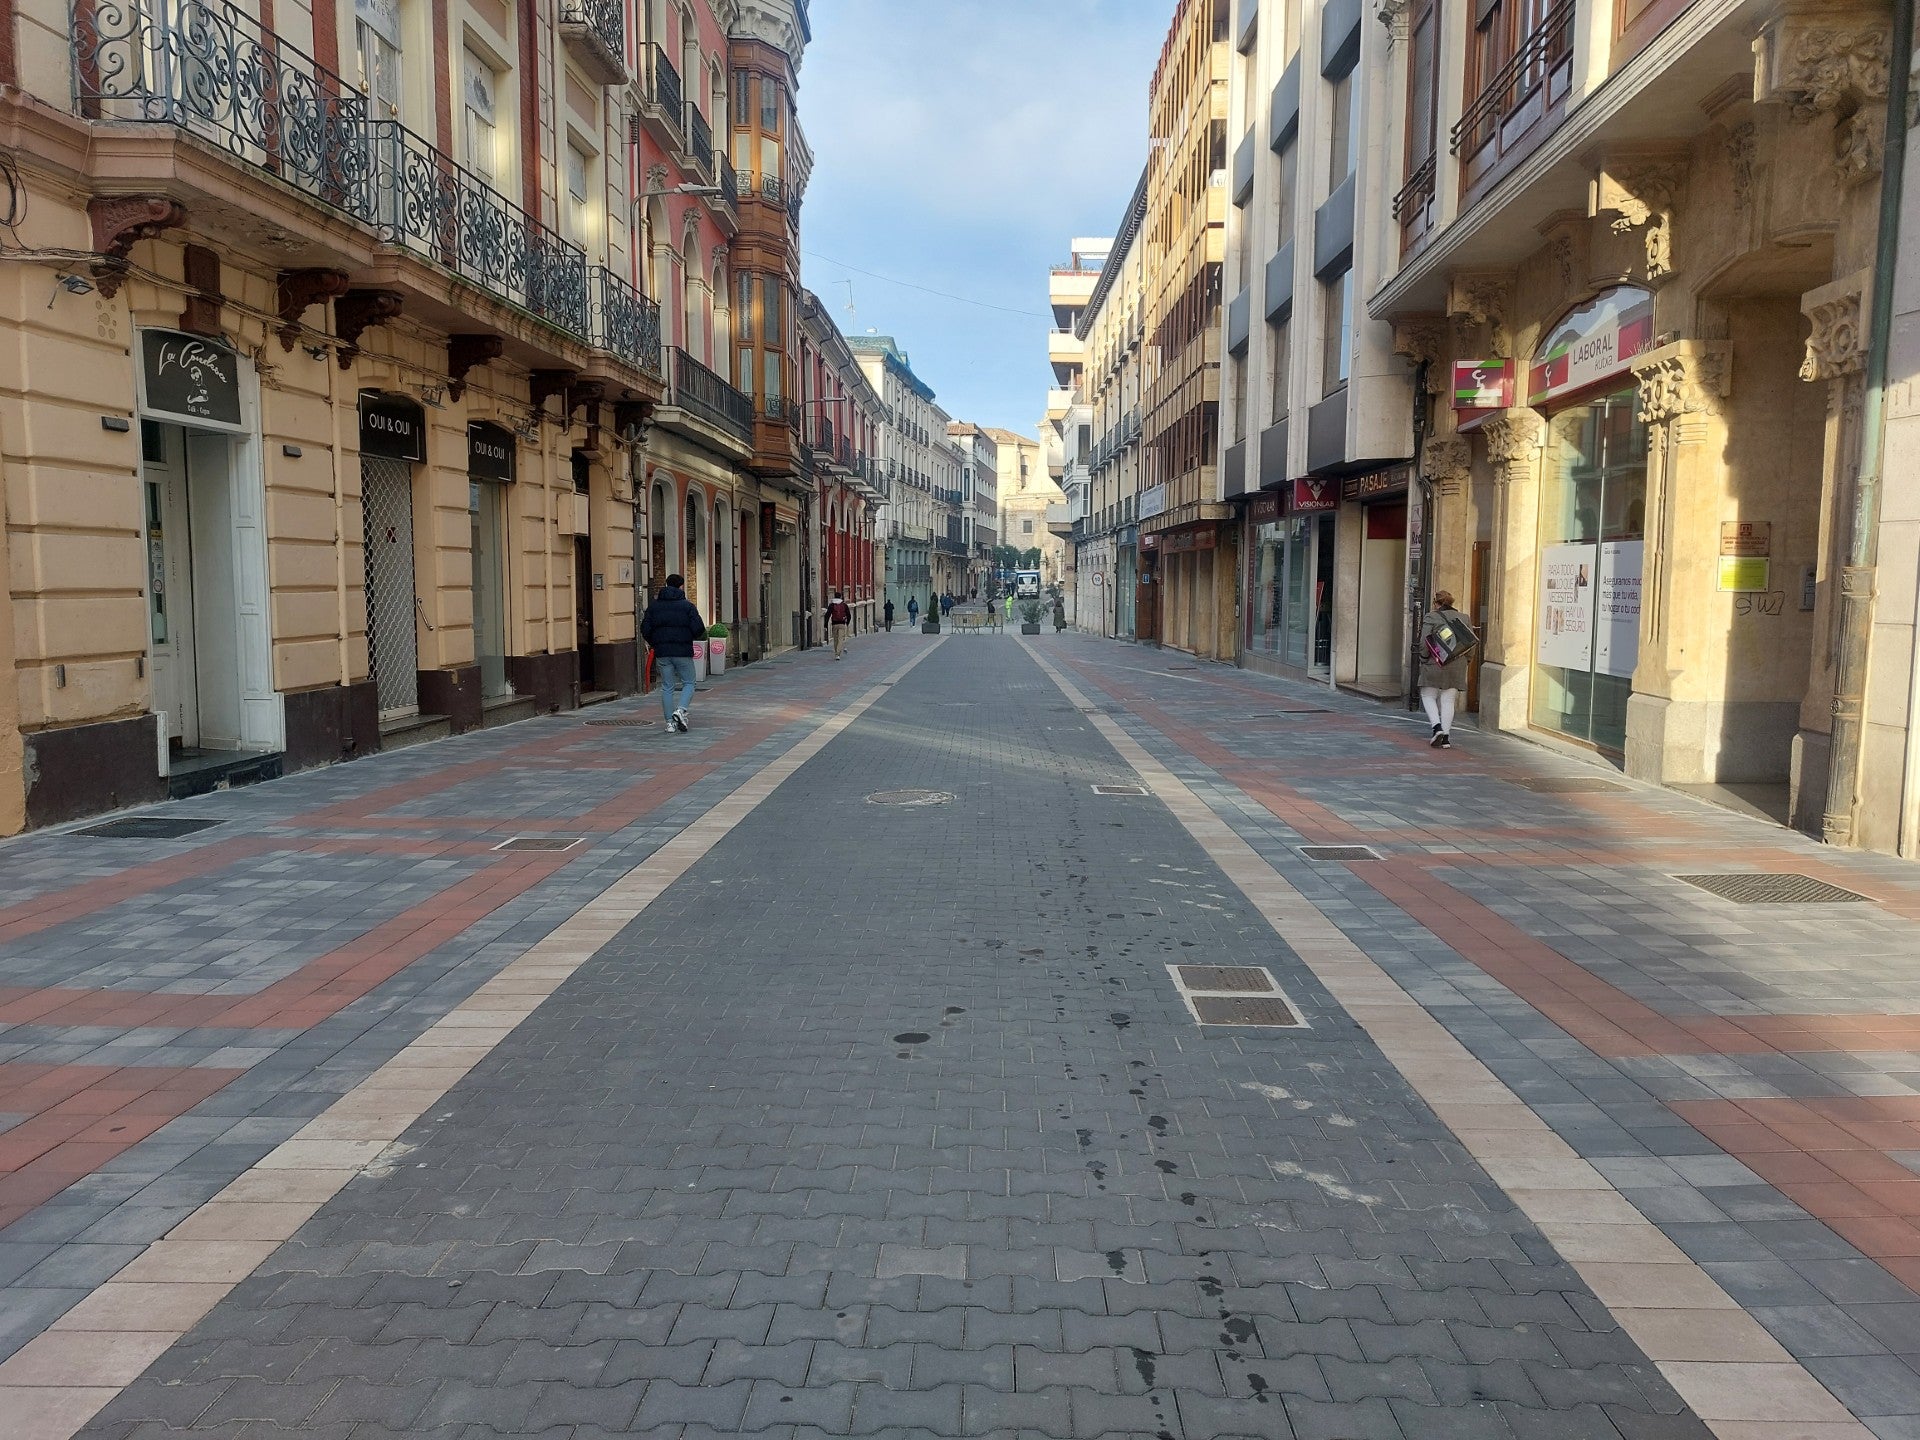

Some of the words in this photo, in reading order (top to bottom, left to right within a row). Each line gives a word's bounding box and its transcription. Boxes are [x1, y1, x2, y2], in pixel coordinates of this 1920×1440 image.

[158, 341, 176, 376] La
[1573, 333, 1613, 365] LABORAL
[1594, 355, 1613, 371] kutxa
[369, 413, 386, 429] OUI
[387, 419, 394, 432] &
[394, 419, 411, 436] OUI
[474, 441, 487, 456] OUI
[488, 445, 493, 457] &
[493, 446, 505, 460] OUI
[1359, 471, 1388, 493] PASAJE
[1298, 500, 1335, 508] VISIONLAB
